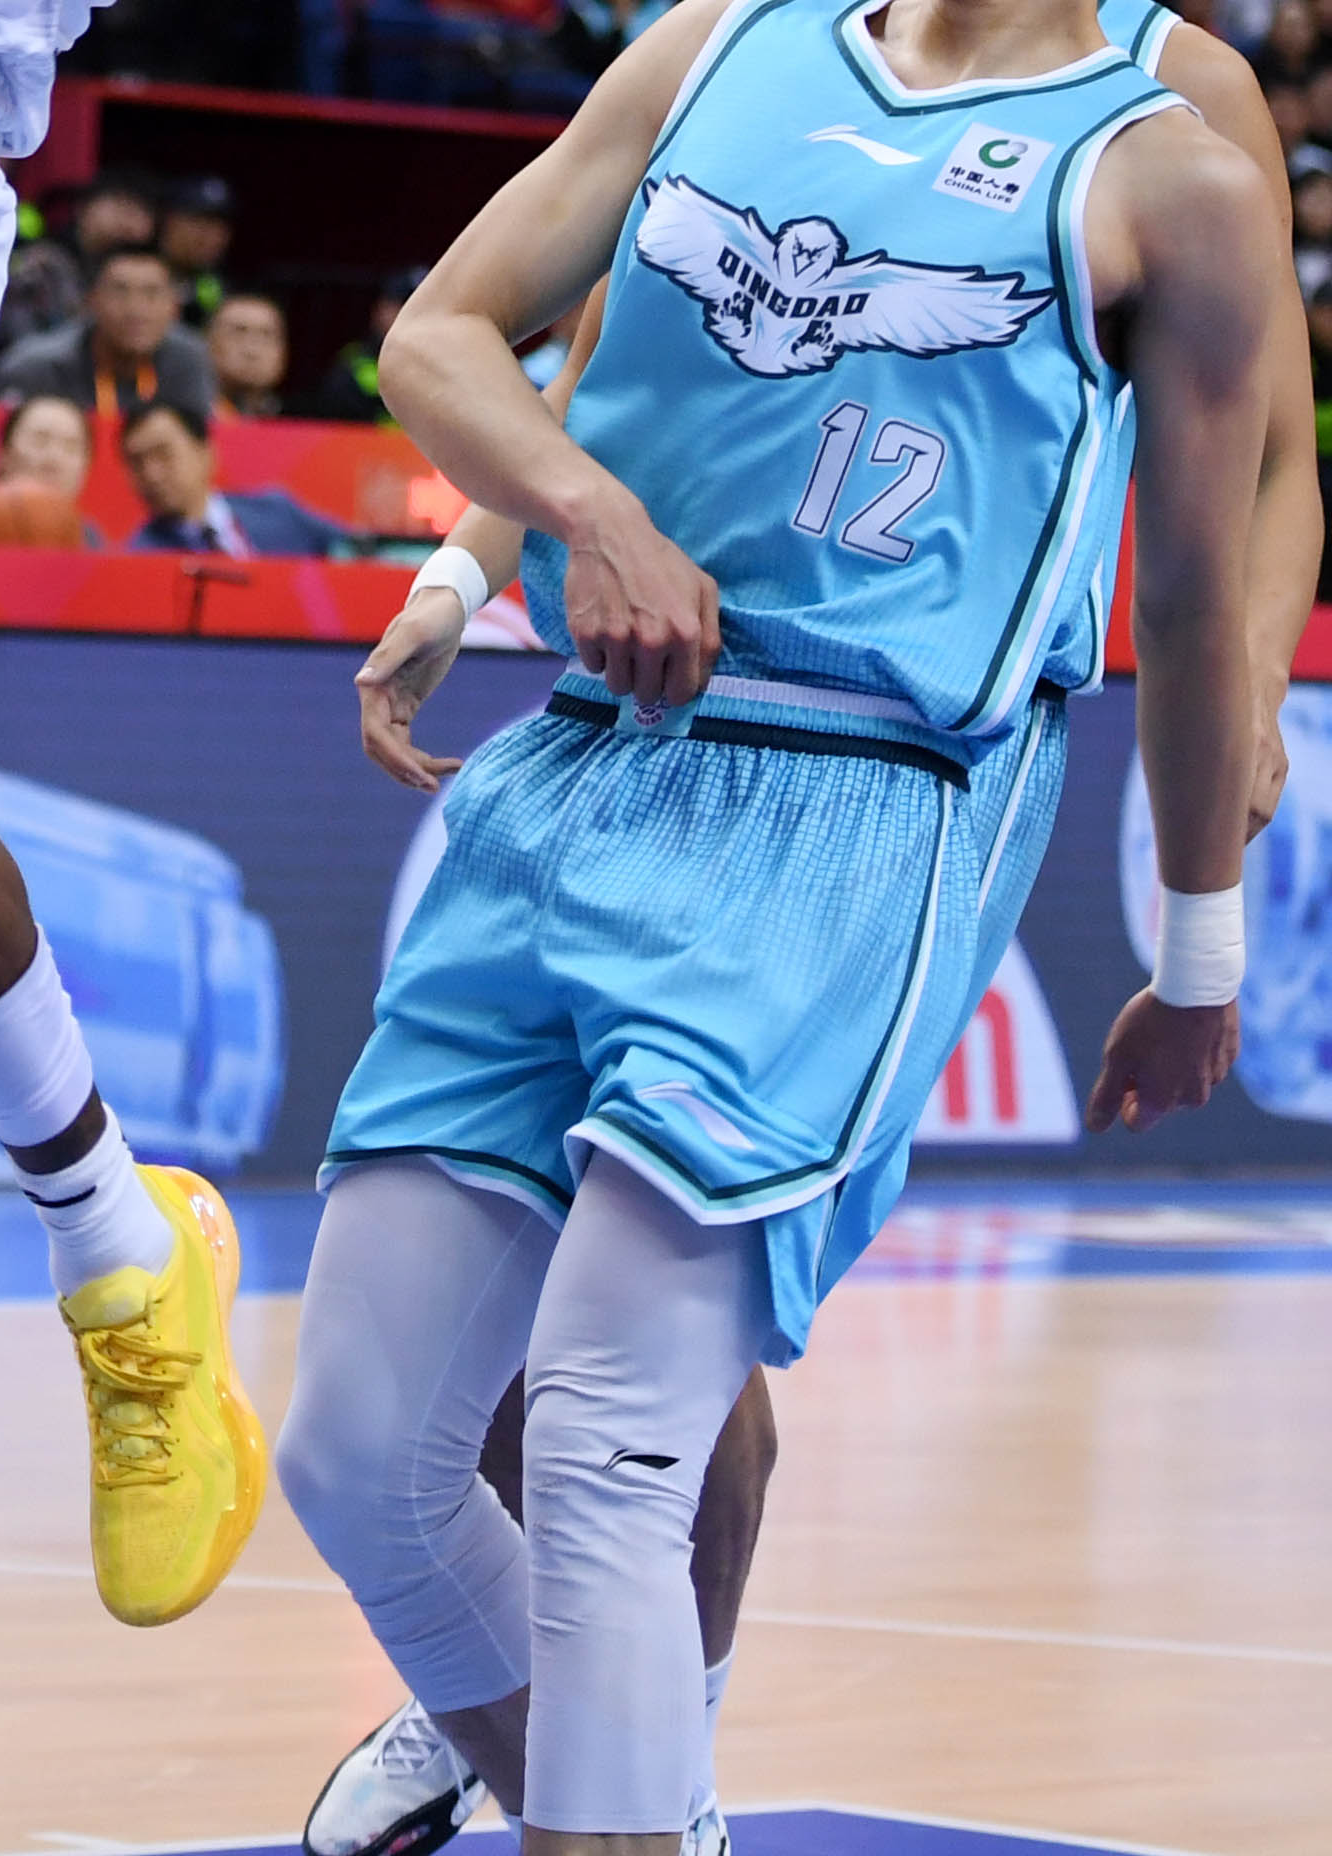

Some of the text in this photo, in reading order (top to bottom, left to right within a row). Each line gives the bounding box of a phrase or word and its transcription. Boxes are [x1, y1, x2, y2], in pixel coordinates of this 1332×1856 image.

[943, 178, 1013, 204] CHINA LIFE
[949, 165, 1020, 195] 中国人寿
[716, 246, 871, 319] QINGDAO
[792, 400, 947, 563] 12
